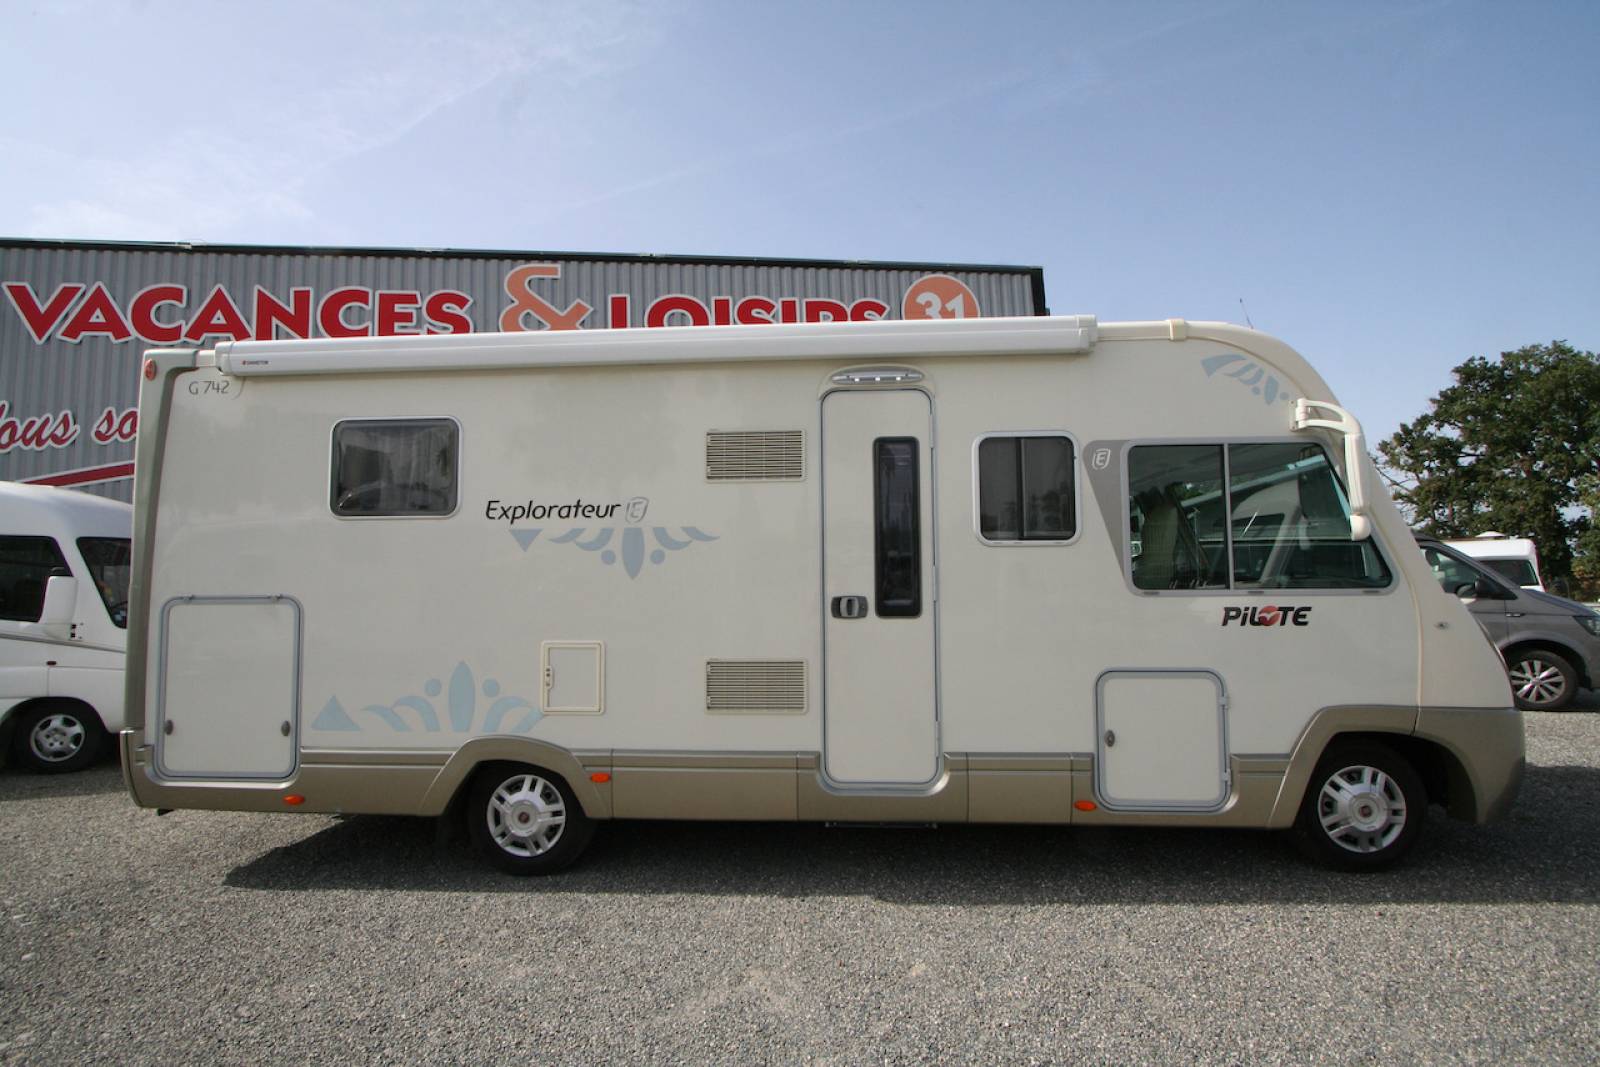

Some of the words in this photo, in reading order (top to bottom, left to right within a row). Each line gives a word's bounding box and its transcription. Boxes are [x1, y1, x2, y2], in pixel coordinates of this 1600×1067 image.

[3, 282, 473, 343] VACANCES
[499, 263, 593, 333] &
[92, 402, 140, 444] so
[485, 499, 622, 525] Explorateur
